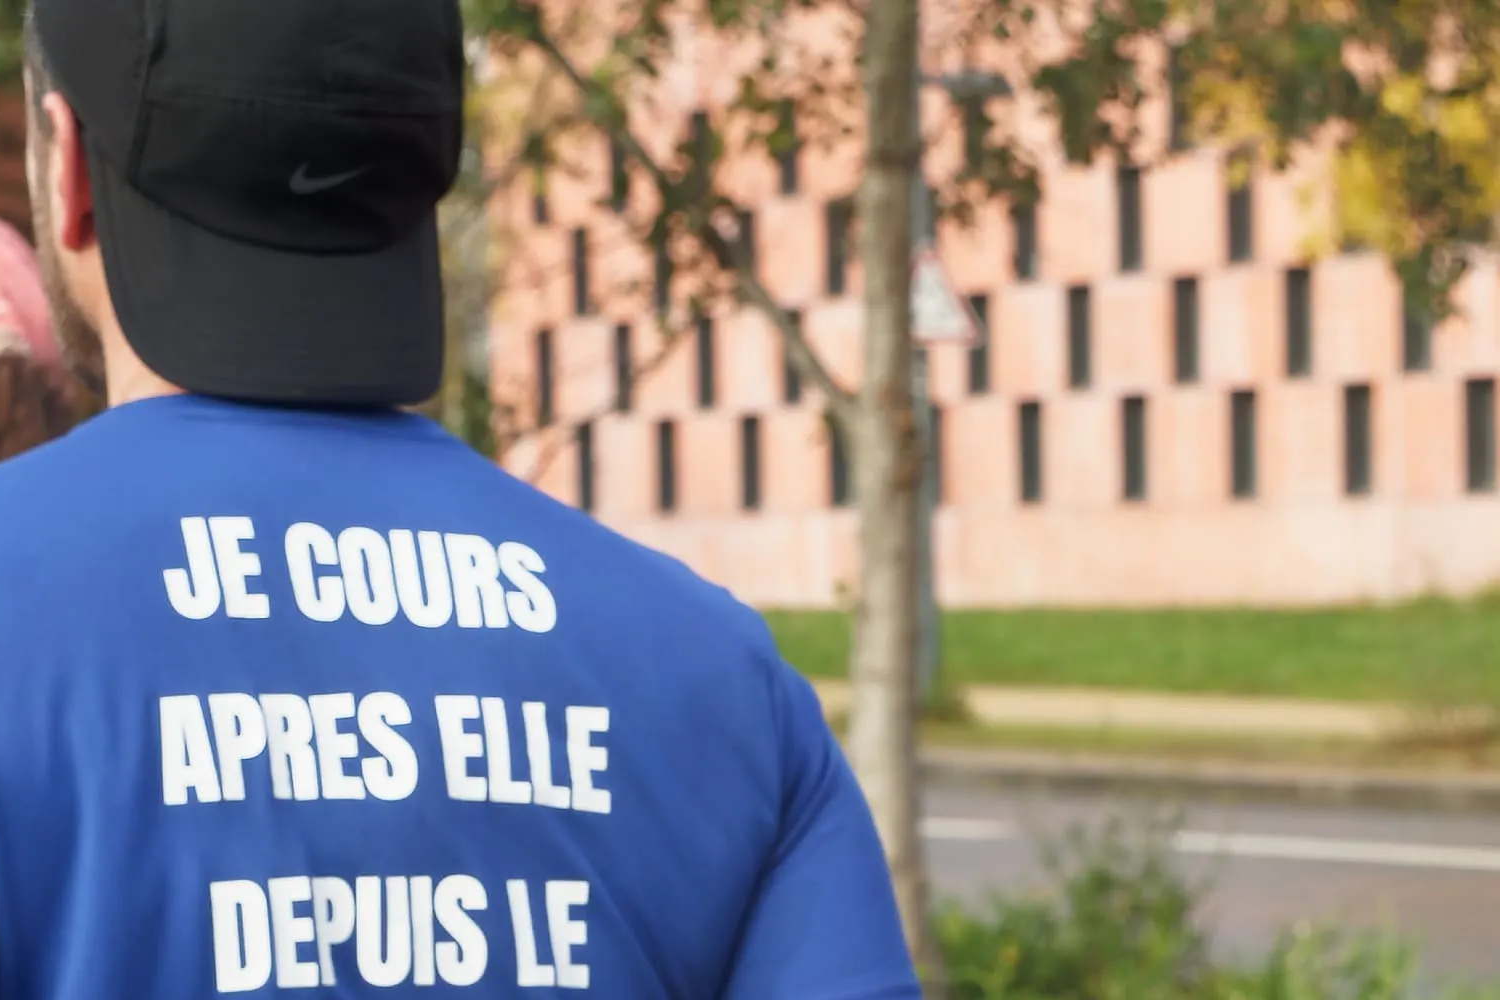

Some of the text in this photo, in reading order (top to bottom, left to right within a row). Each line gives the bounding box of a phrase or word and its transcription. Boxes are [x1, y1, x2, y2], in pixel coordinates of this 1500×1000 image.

[163, 516, 557, 633] JE COURS
[159, 691, 612, 814] APRES ELLE
[209, 874, 590, 993] DEPUIS LE
